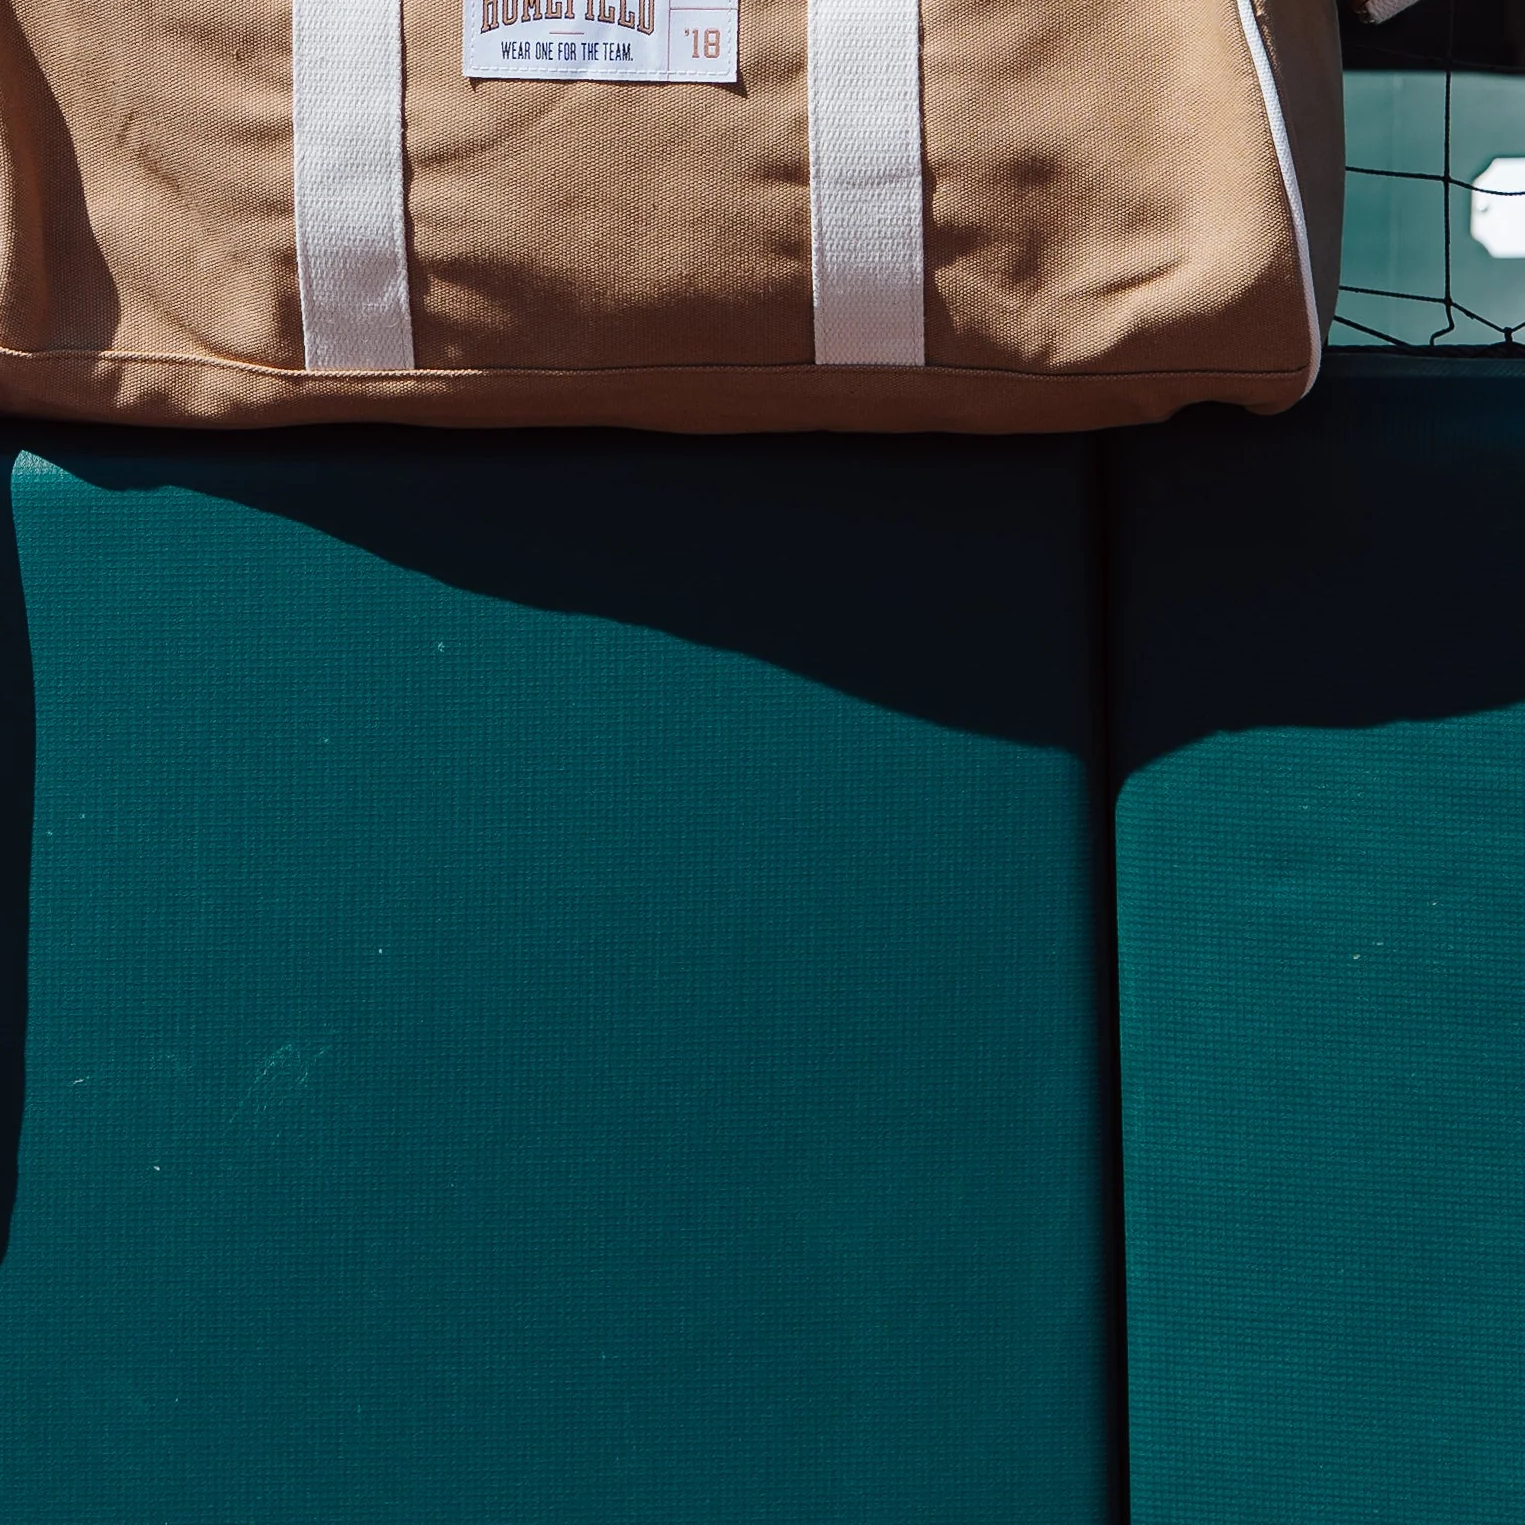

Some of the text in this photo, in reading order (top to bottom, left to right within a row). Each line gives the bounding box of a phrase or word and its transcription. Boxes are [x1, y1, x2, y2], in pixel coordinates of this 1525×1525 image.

[501, 41, 634, 62] WEAR ONE FOR THE TEAM.
[684, 28, 721, 59] '18
